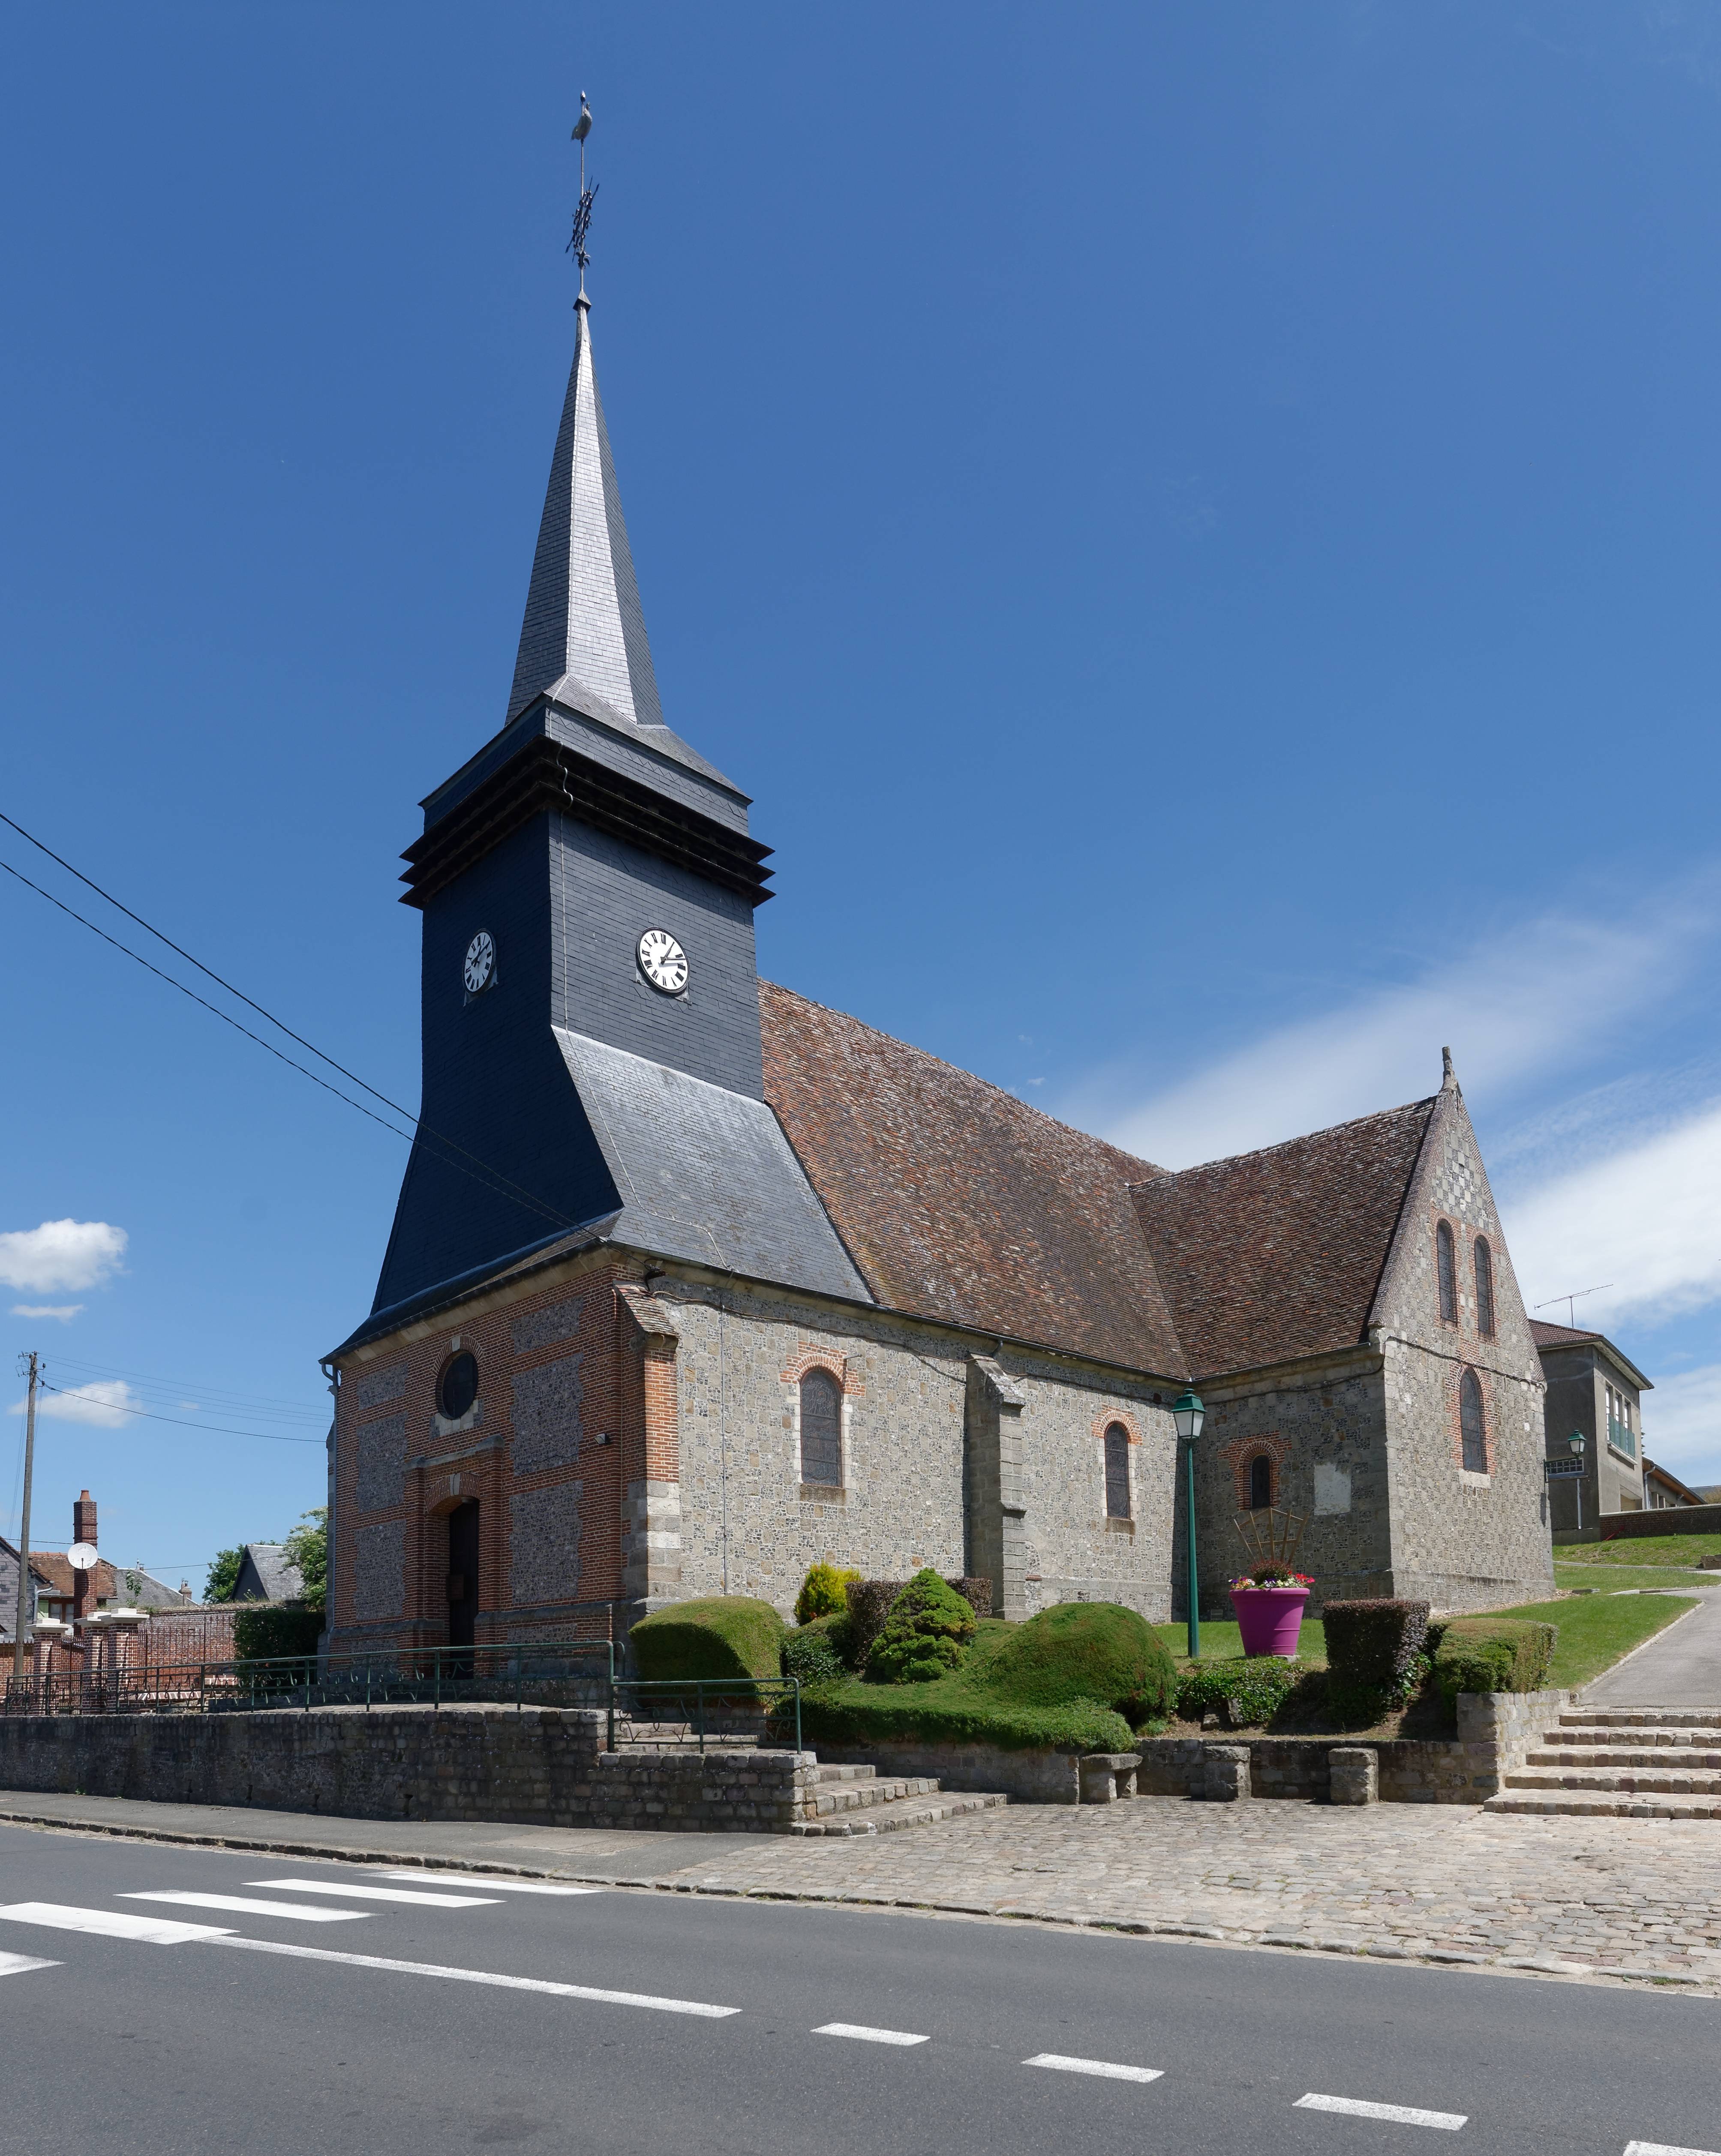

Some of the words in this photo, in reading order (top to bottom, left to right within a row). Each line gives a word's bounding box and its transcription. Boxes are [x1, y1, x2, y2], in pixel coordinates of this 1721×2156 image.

[644, 938, 652, 949] X
[651, 933, 658, 944] XI
[642, 949, 650, 957] IX
[671, 977, 677, 987] V
